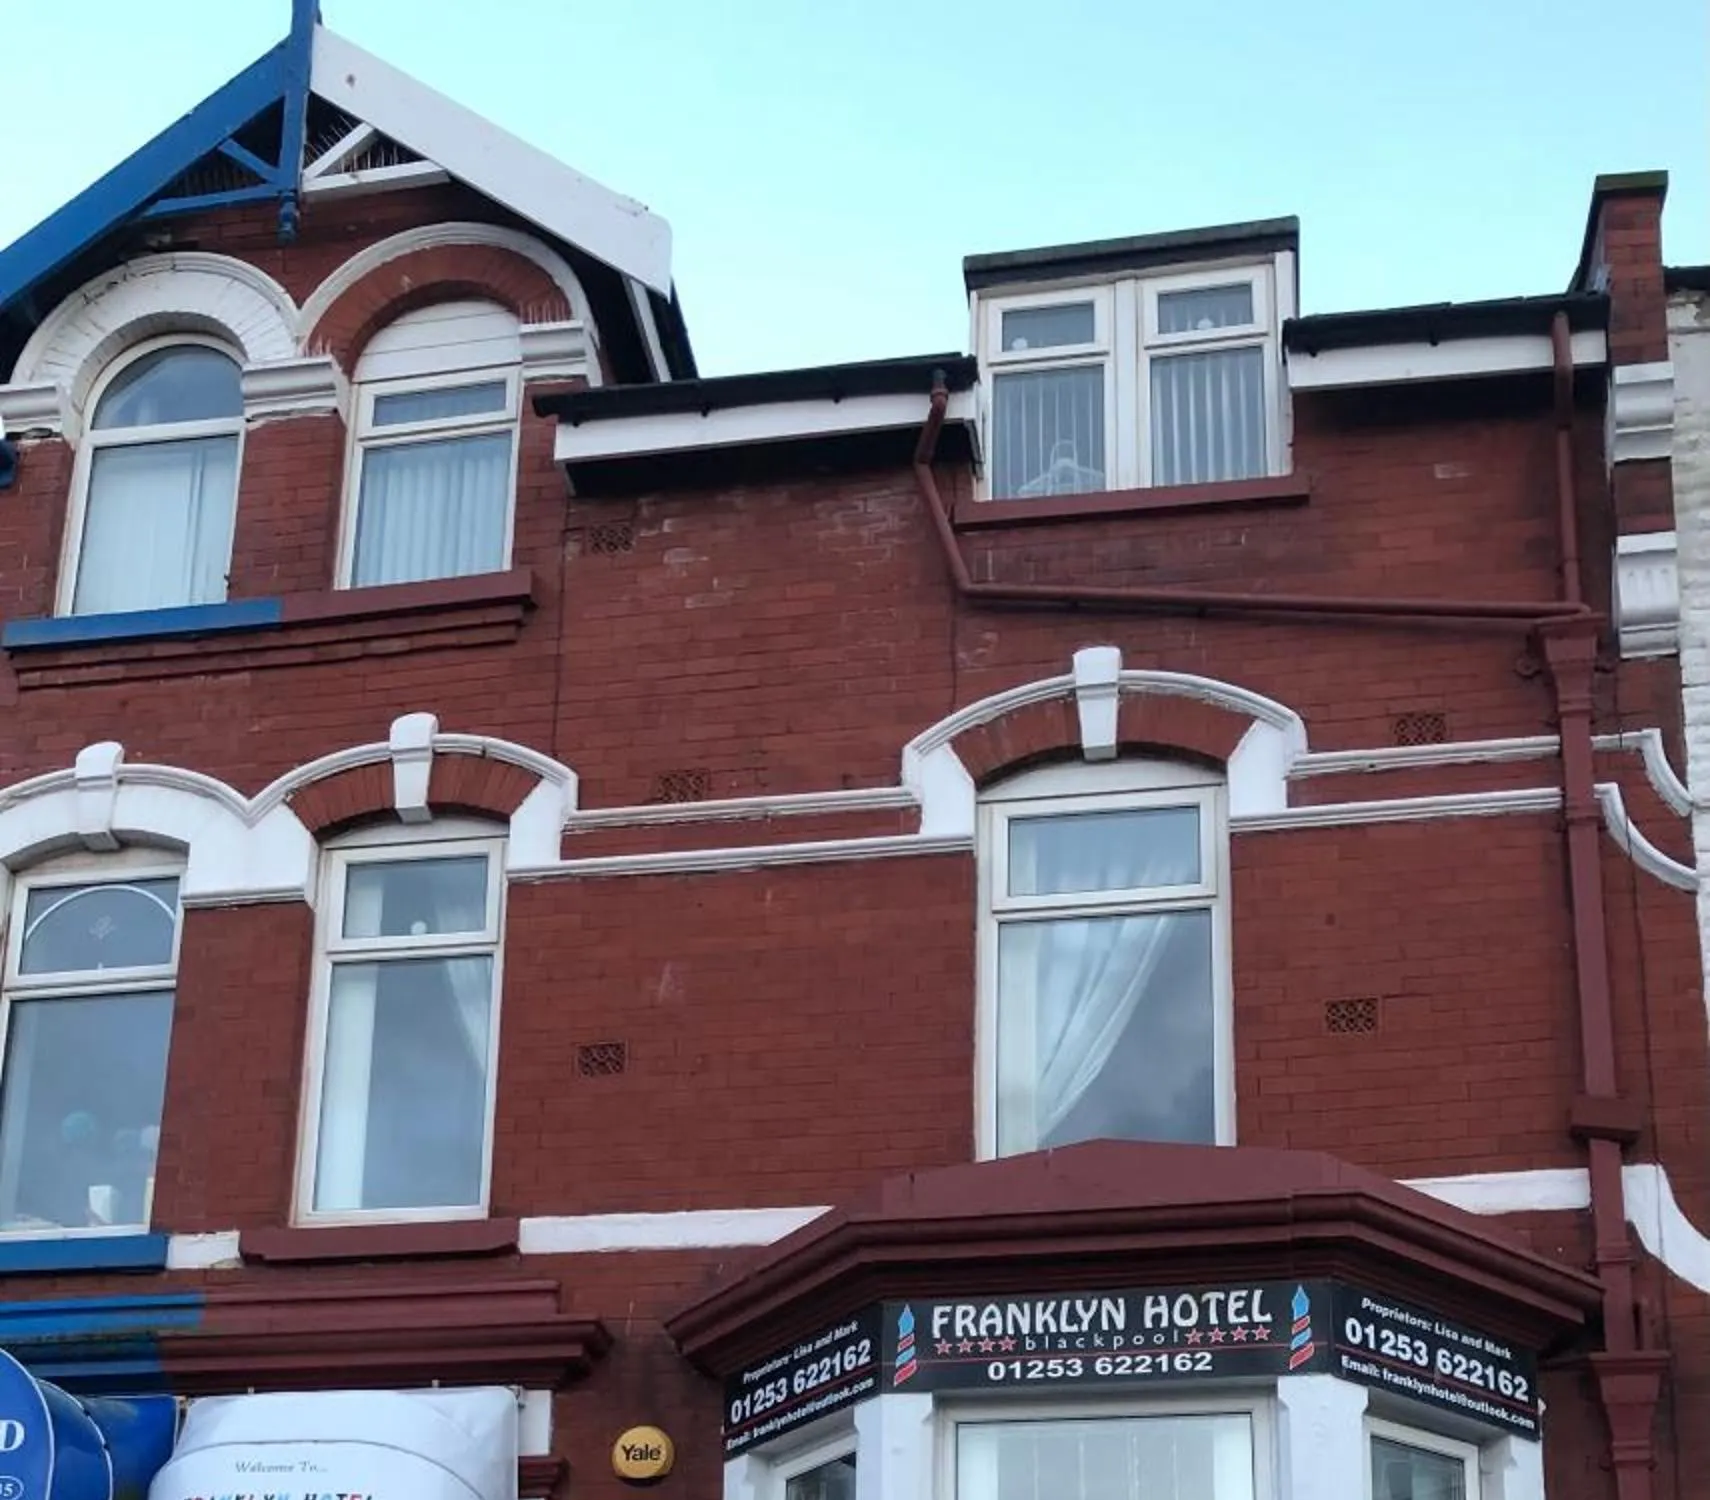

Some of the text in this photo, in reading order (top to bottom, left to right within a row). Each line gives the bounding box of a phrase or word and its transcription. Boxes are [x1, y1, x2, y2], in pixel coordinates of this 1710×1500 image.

[932, 1288, 1273, 1339] FRANKLYN HOTEL
[1361, 1297, 1512, 1361] Proprietors: Lisa and Mark
[1026, 1326, 1179, 1352] blackpool
[987, 1351, 1214, 1382] 01253 622162
[1345, 1317, 1530, 1403] 01253 622162
[730, 1338, 872, 1425] 01253 622162
[235, 1461, 294, 1474] Welcome
[621, 1443, 662, 1462] Yale
